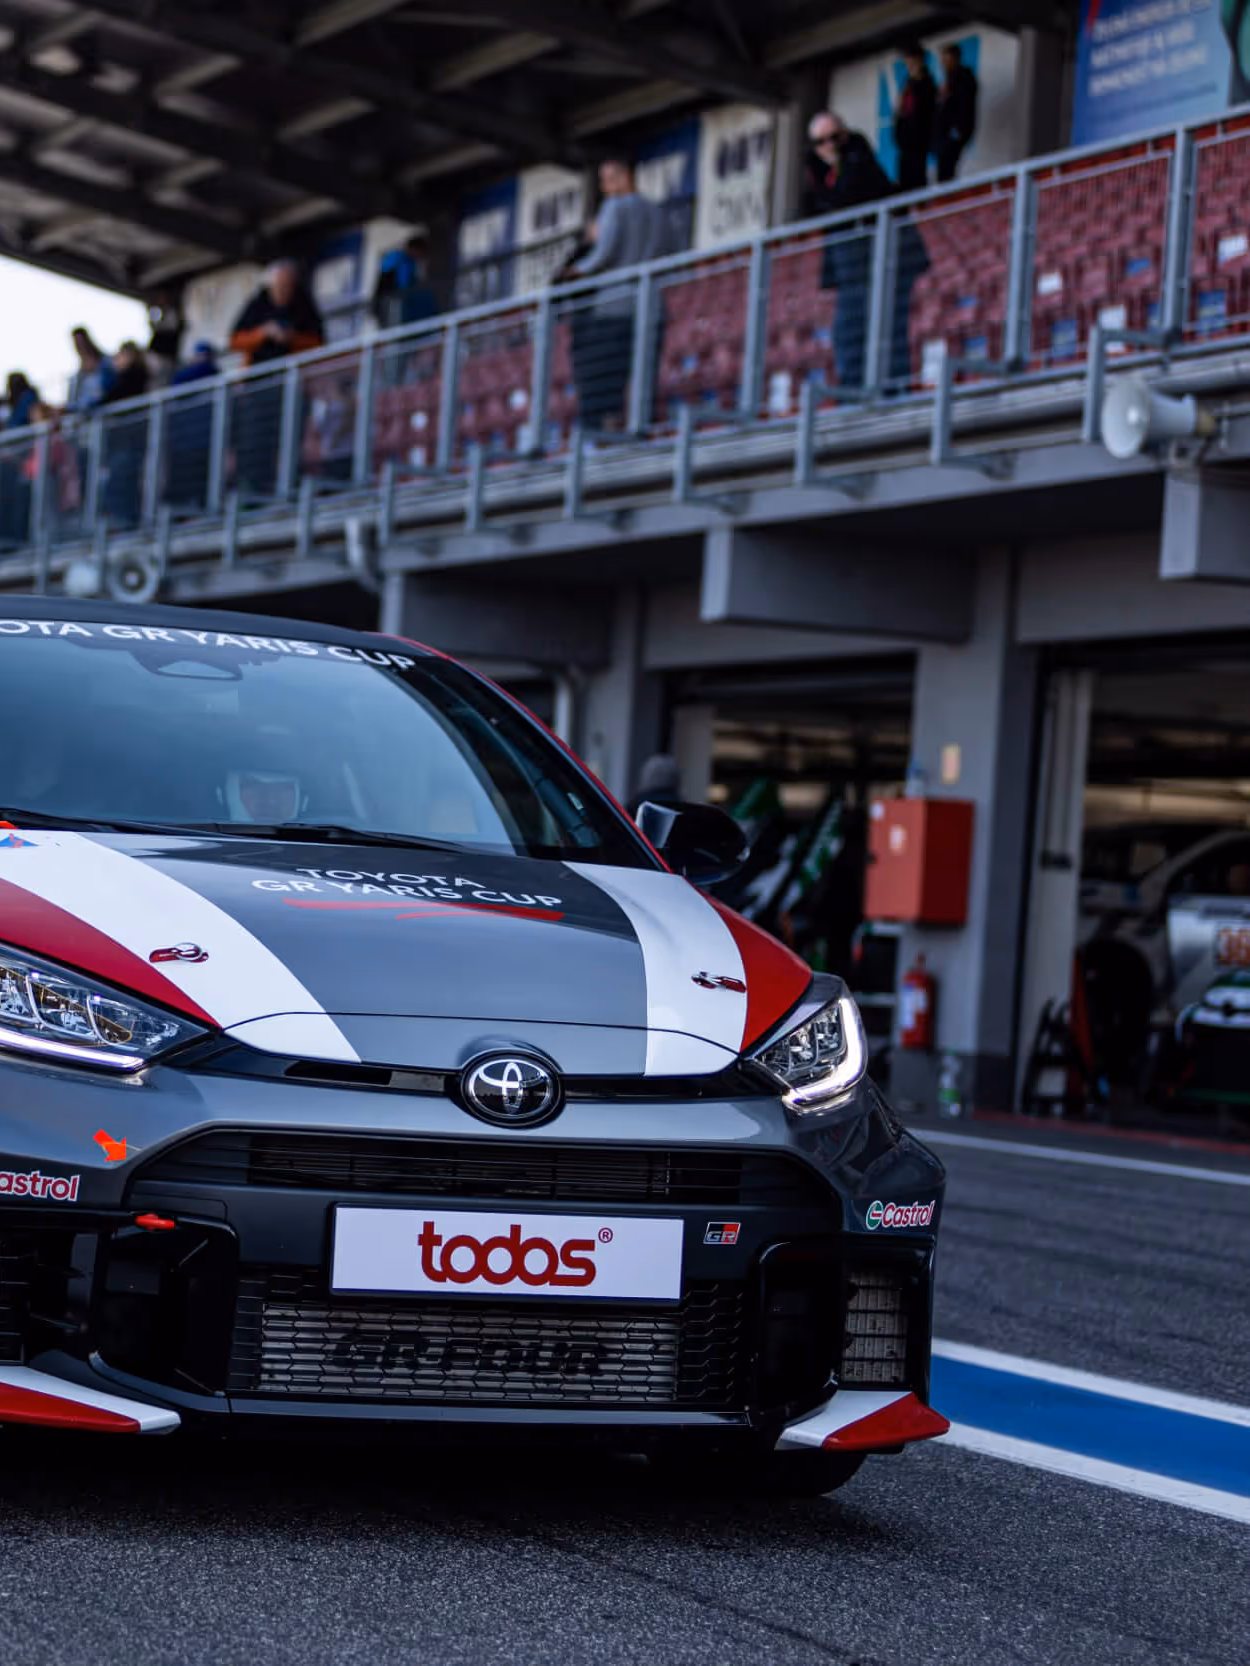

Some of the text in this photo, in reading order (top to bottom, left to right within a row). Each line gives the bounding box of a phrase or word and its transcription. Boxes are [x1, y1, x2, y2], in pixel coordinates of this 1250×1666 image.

[102, 625, 175, 642] GR
[180, 629, 319, 656] YARIS
[327, 646, 416, 670] CUP
[296, 868, 487, 889] TOYOTA
[251, 879, 563, 907] GR YARIS CUP
[881, 1200, 936, 1228] Castrol
